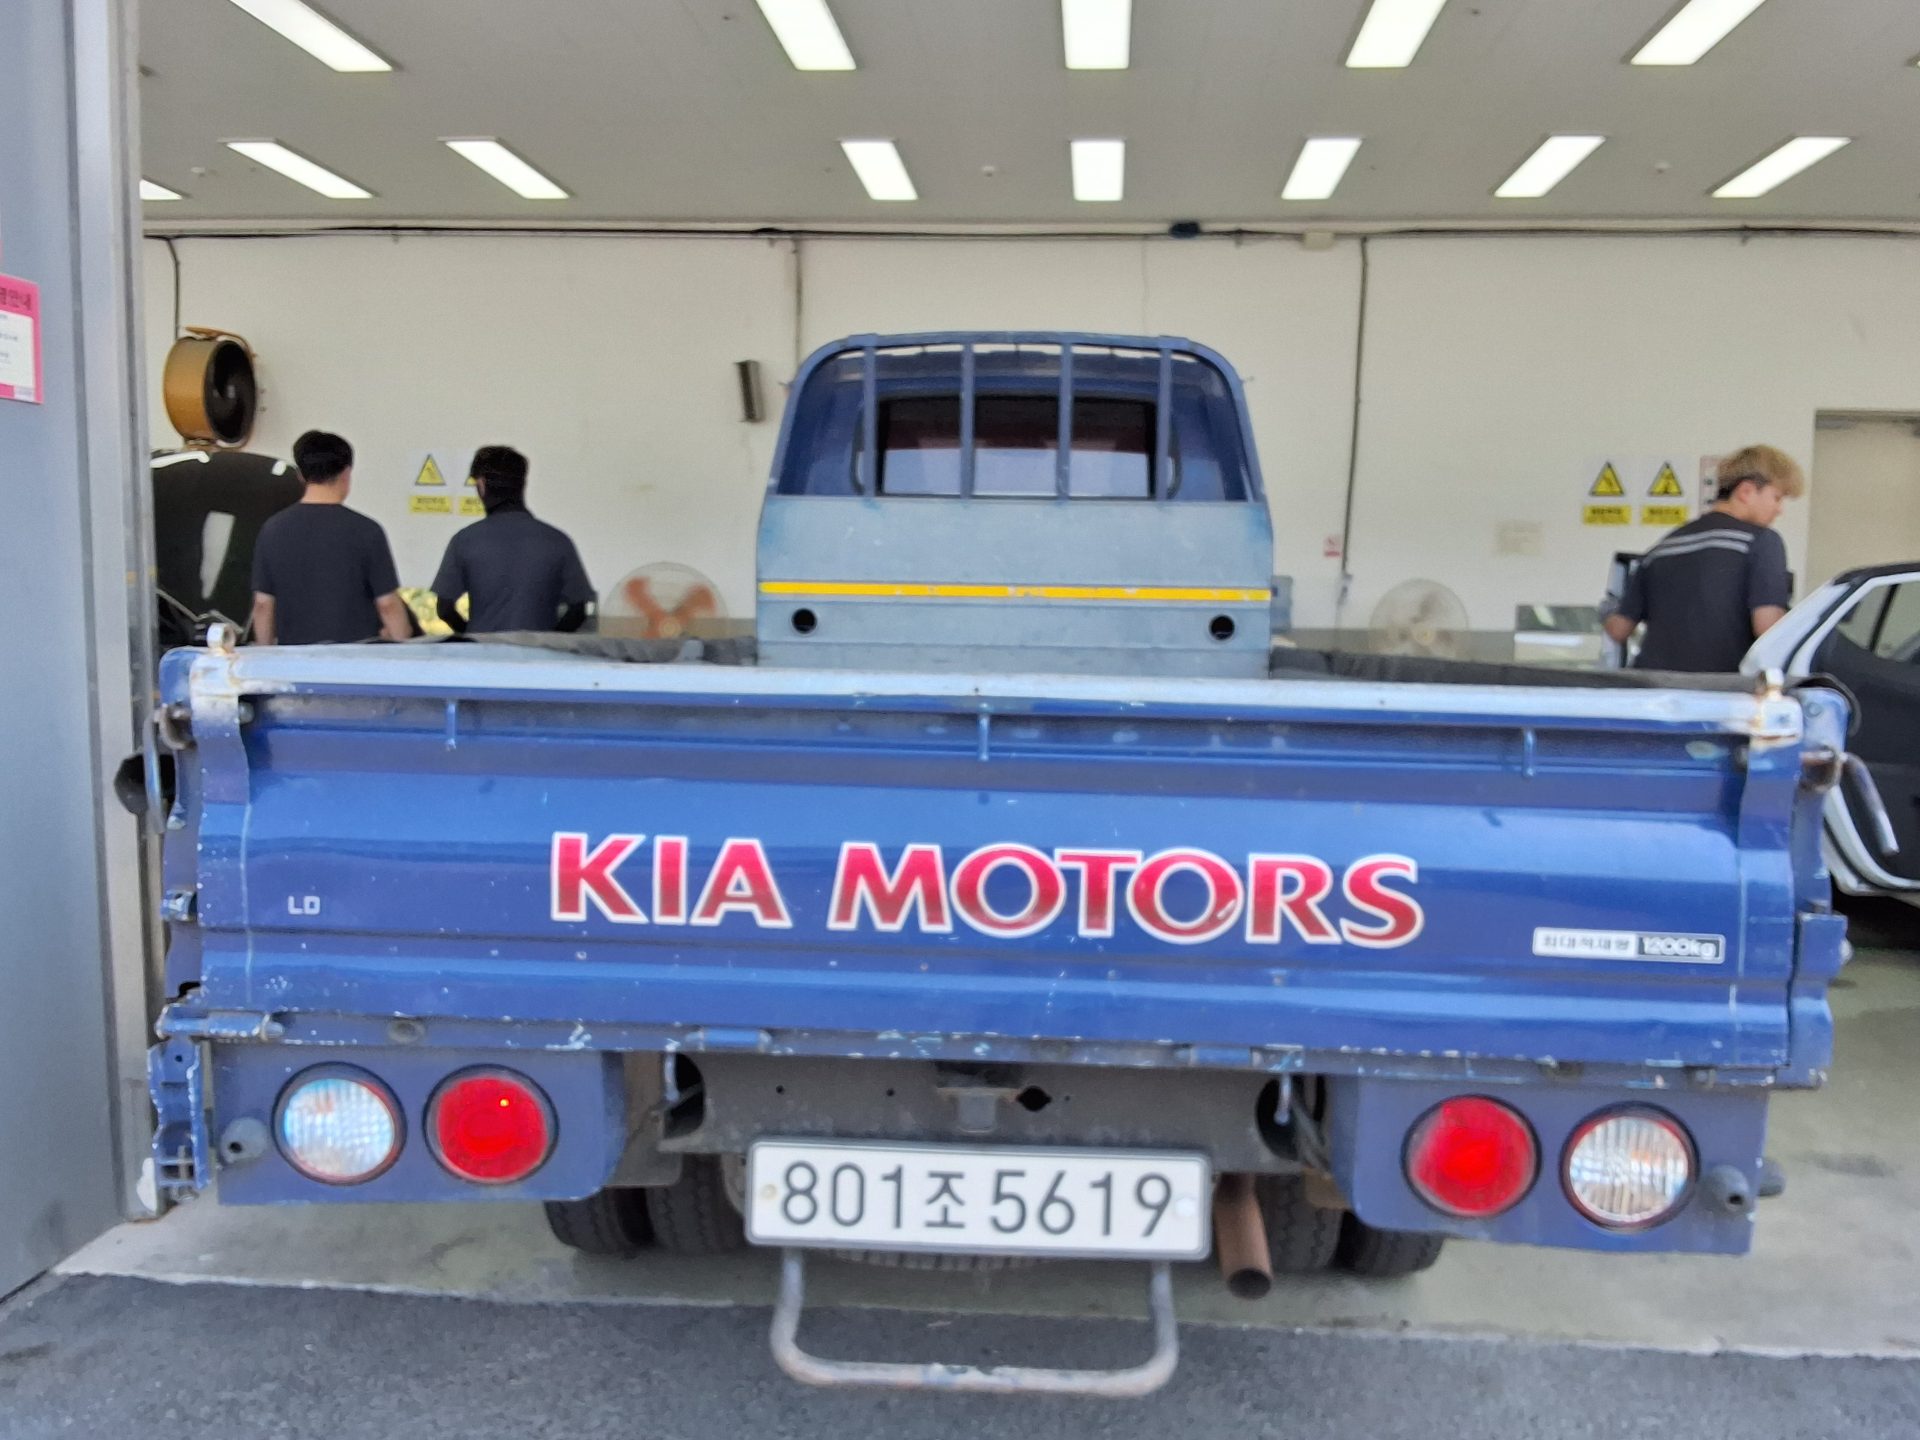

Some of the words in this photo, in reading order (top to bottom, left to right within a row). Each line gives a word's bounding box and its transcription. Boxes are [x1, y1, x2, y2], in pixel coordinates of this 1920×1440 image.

[551, 832, 792, 929] KIA
[827, 841, 1425, 949] MOTORS
[990, 1171, 1173, 1237] 5619
